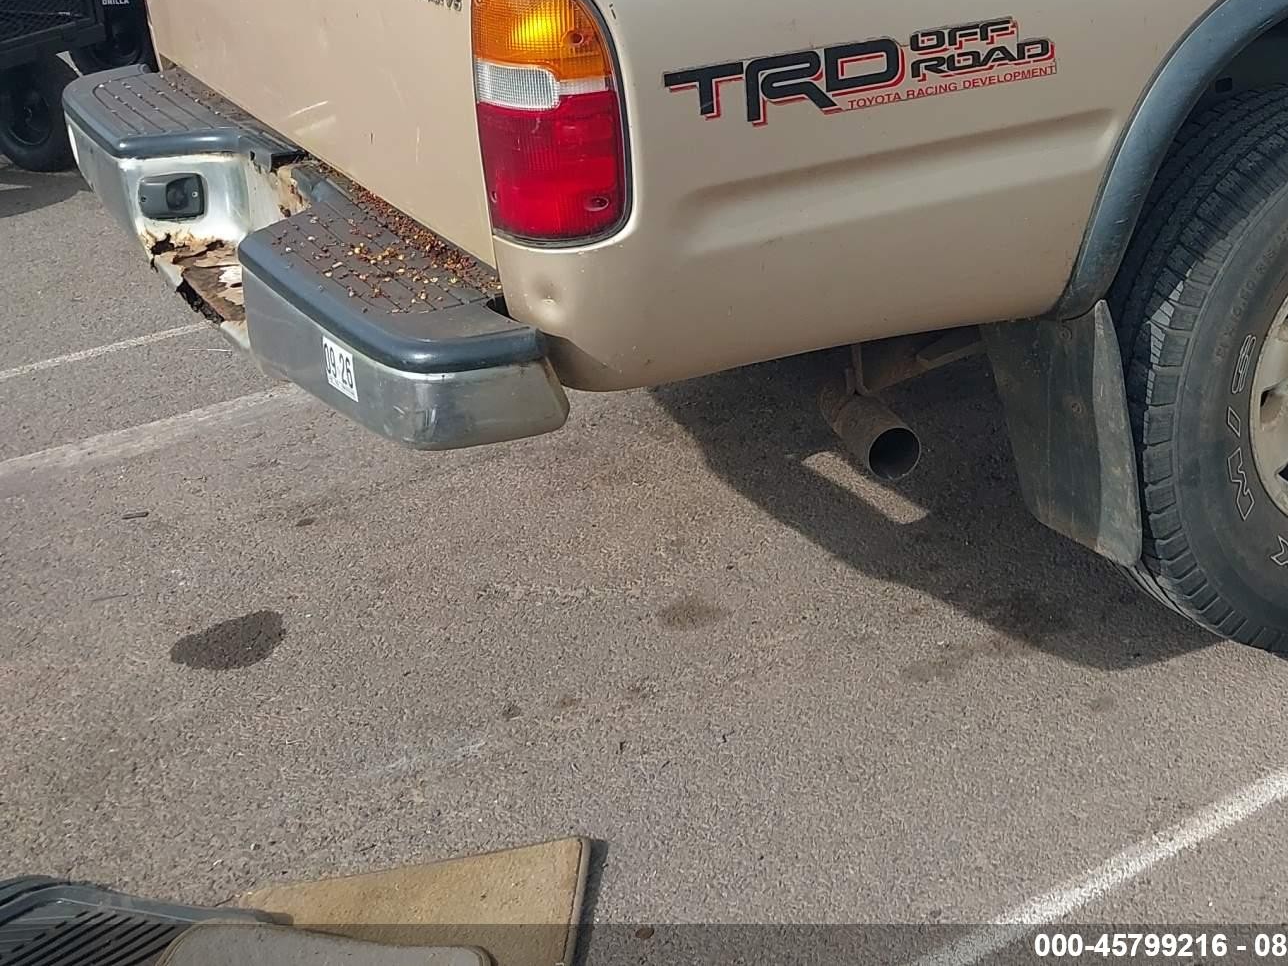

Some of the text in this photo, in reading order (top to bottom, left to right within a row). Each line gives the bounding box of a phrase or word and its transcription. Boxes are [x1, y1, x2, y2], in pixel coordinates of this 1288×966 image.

[910, 18, 1018, 55] OFF
[663, 38, 905, 127] TRD
[911, 38, 1055, 82] ROAD
[848, 64, 1057, 111] TOYOTA RACING DEVELOPMENT
